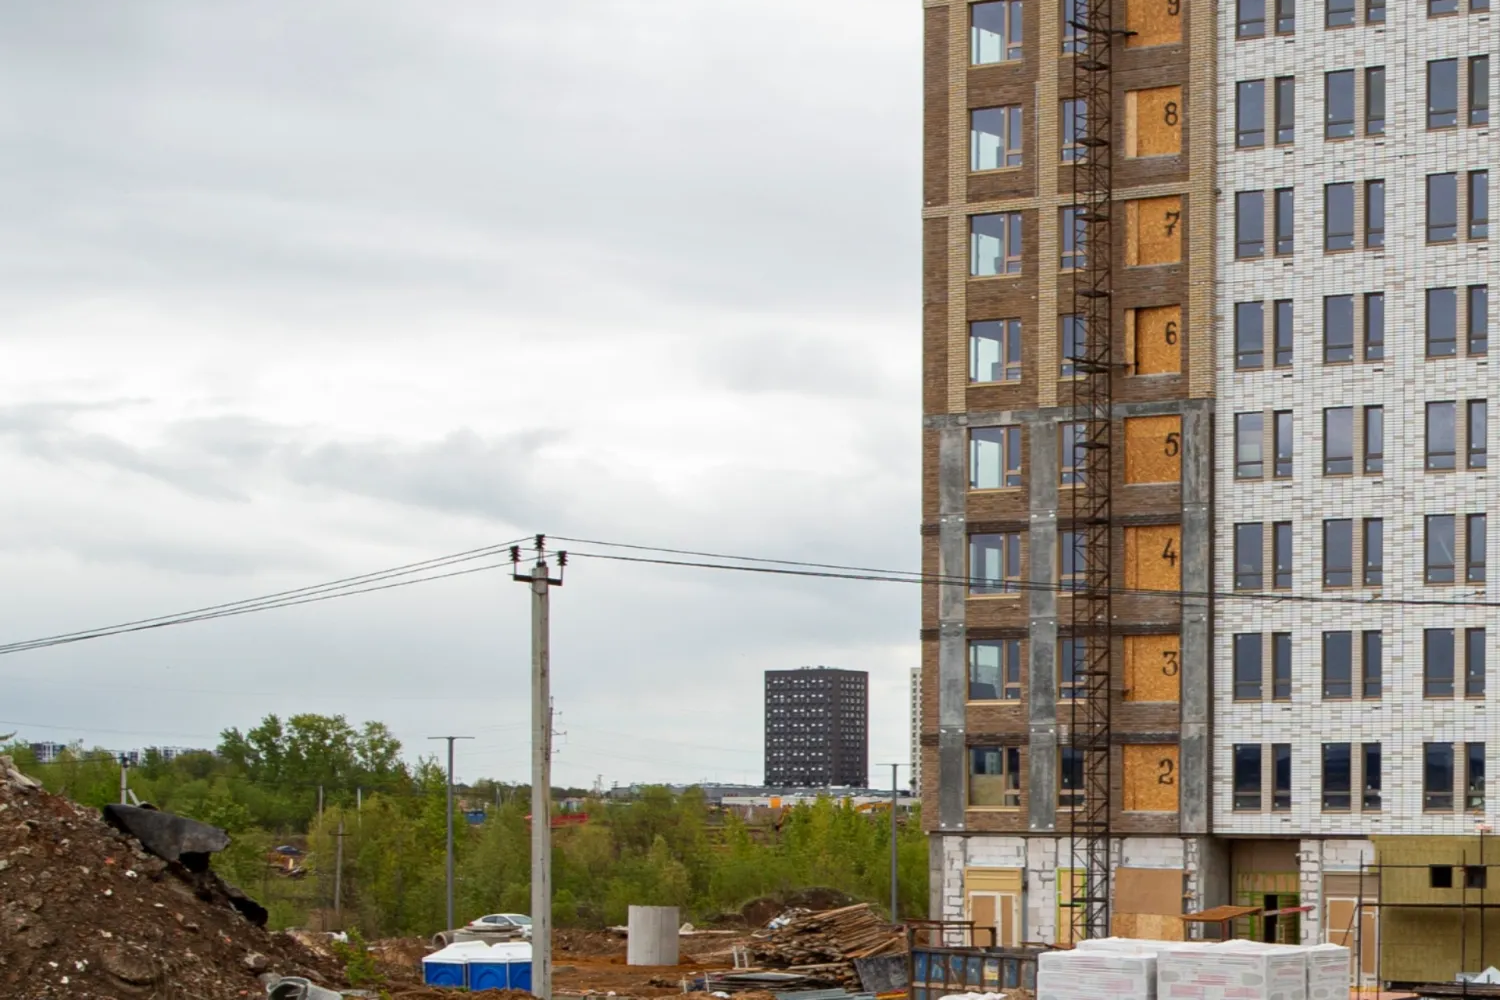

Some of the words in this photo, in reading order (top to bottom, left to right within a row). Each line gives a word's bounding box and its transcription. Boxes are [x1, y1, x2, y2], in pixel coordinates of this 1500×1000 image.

[1164, 101, 1178, 127] 8
[1163, 211, 1180, 236] 7
[1165, 320, 1178, 346] 6
[1164, 432, 1180, 458] 5
[1161, 537, 1177, 567] 4
[1162, 650, 1179, 677] 3
[1158, 758, 1174, 785] 2
